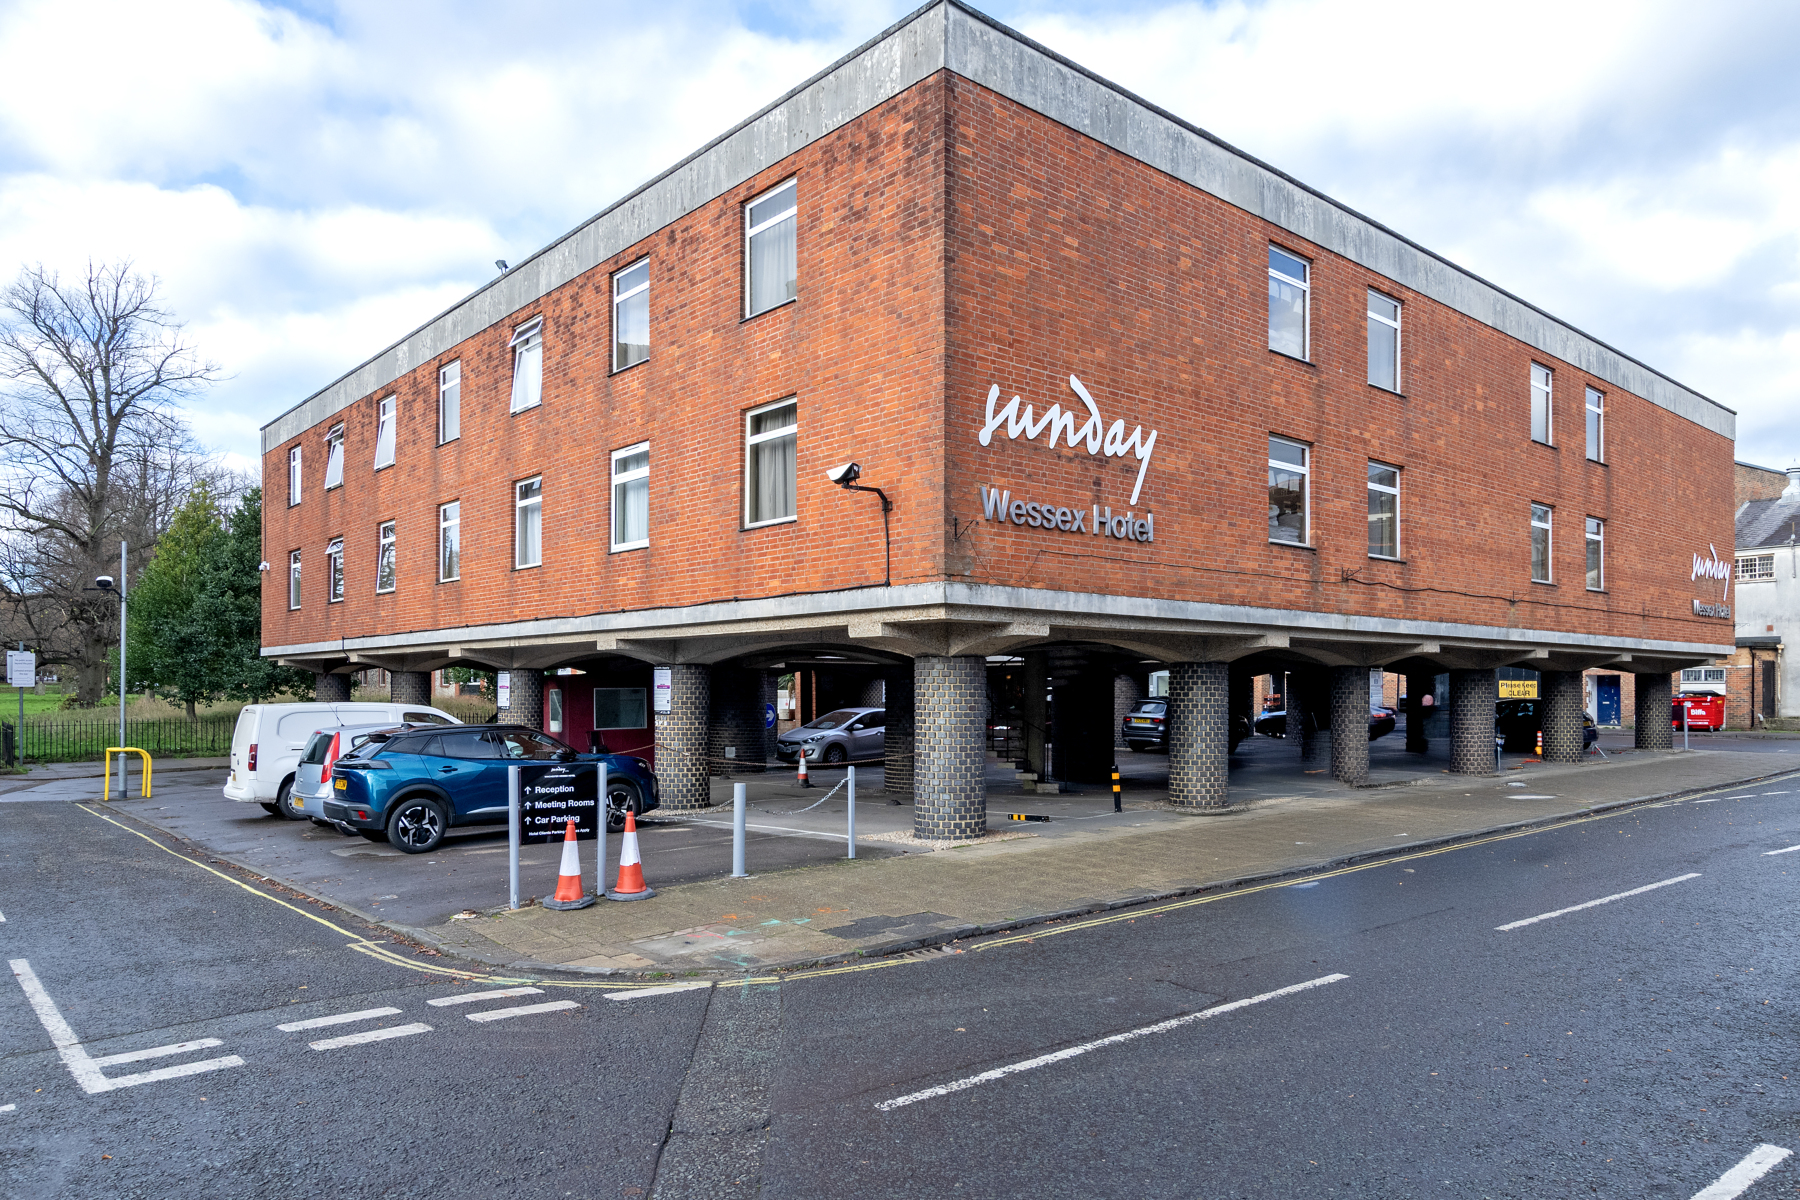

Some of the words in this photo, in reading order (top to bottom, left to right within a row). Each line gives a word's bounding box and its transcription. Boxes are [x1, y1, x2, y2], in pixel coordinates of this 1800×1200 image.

[979, 374, 1157, 505] sunday
[980, 486, 1086, 533] Wessex
[1093, 504, 1154, 542] Hotel
[1691, 543, 1731, 601] sunday
[1693, 599, 1714, 617] Wessex
[1715, 602, 1731, 618] Hotel
[535, 786, 574, 794] Reception
[550, 815, 580, 824] Parking
